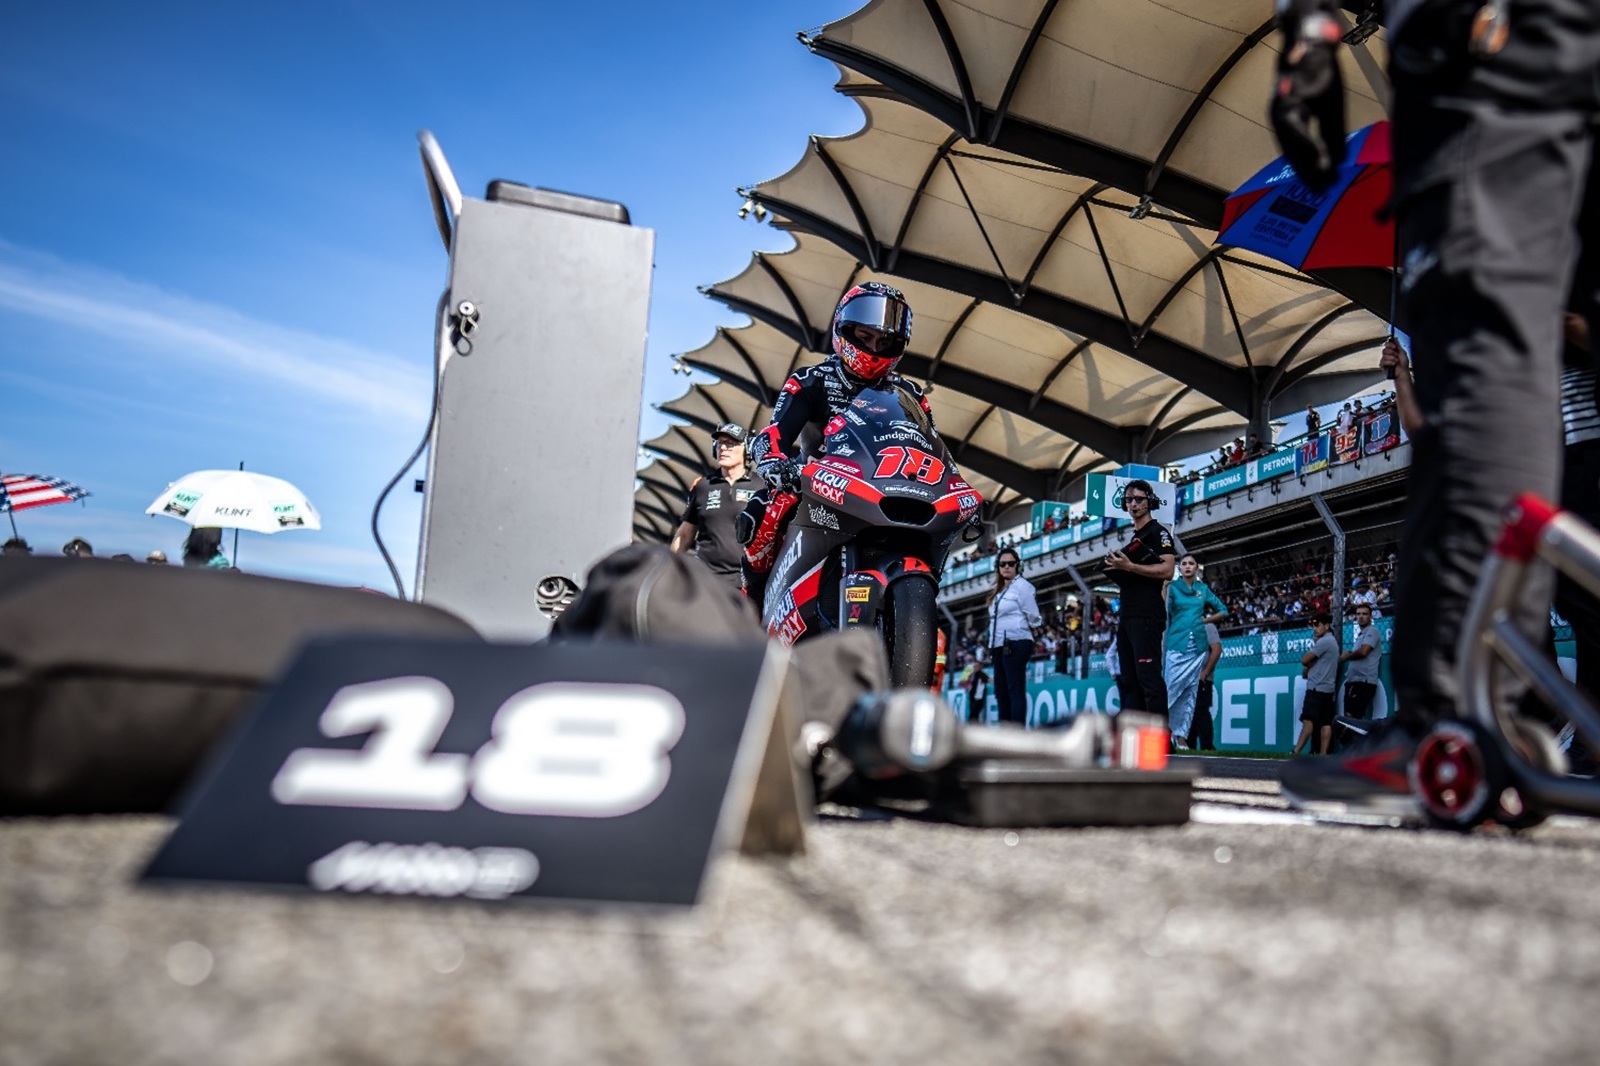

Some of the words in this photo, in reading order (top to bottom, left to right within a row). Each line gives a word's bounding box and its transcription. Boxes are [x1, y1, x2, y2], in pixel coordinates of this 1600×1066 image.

[1335, 426, 1358, 454] 92
[873, 446, 946, 486] 18
[1263, 453, 1296, 473] PETRONA
[814, 469, 849, 490] LIQUI
[1208, 473, 1241, 491] PETRONAS
[812, 480, 844, 502] MOLY
[1092, 490, 1099, 500] 4
[215, 506, 253, 518] KLINT
[1286, 639, 1315, 653] PETR
[272, 675, 687, 819] 18
